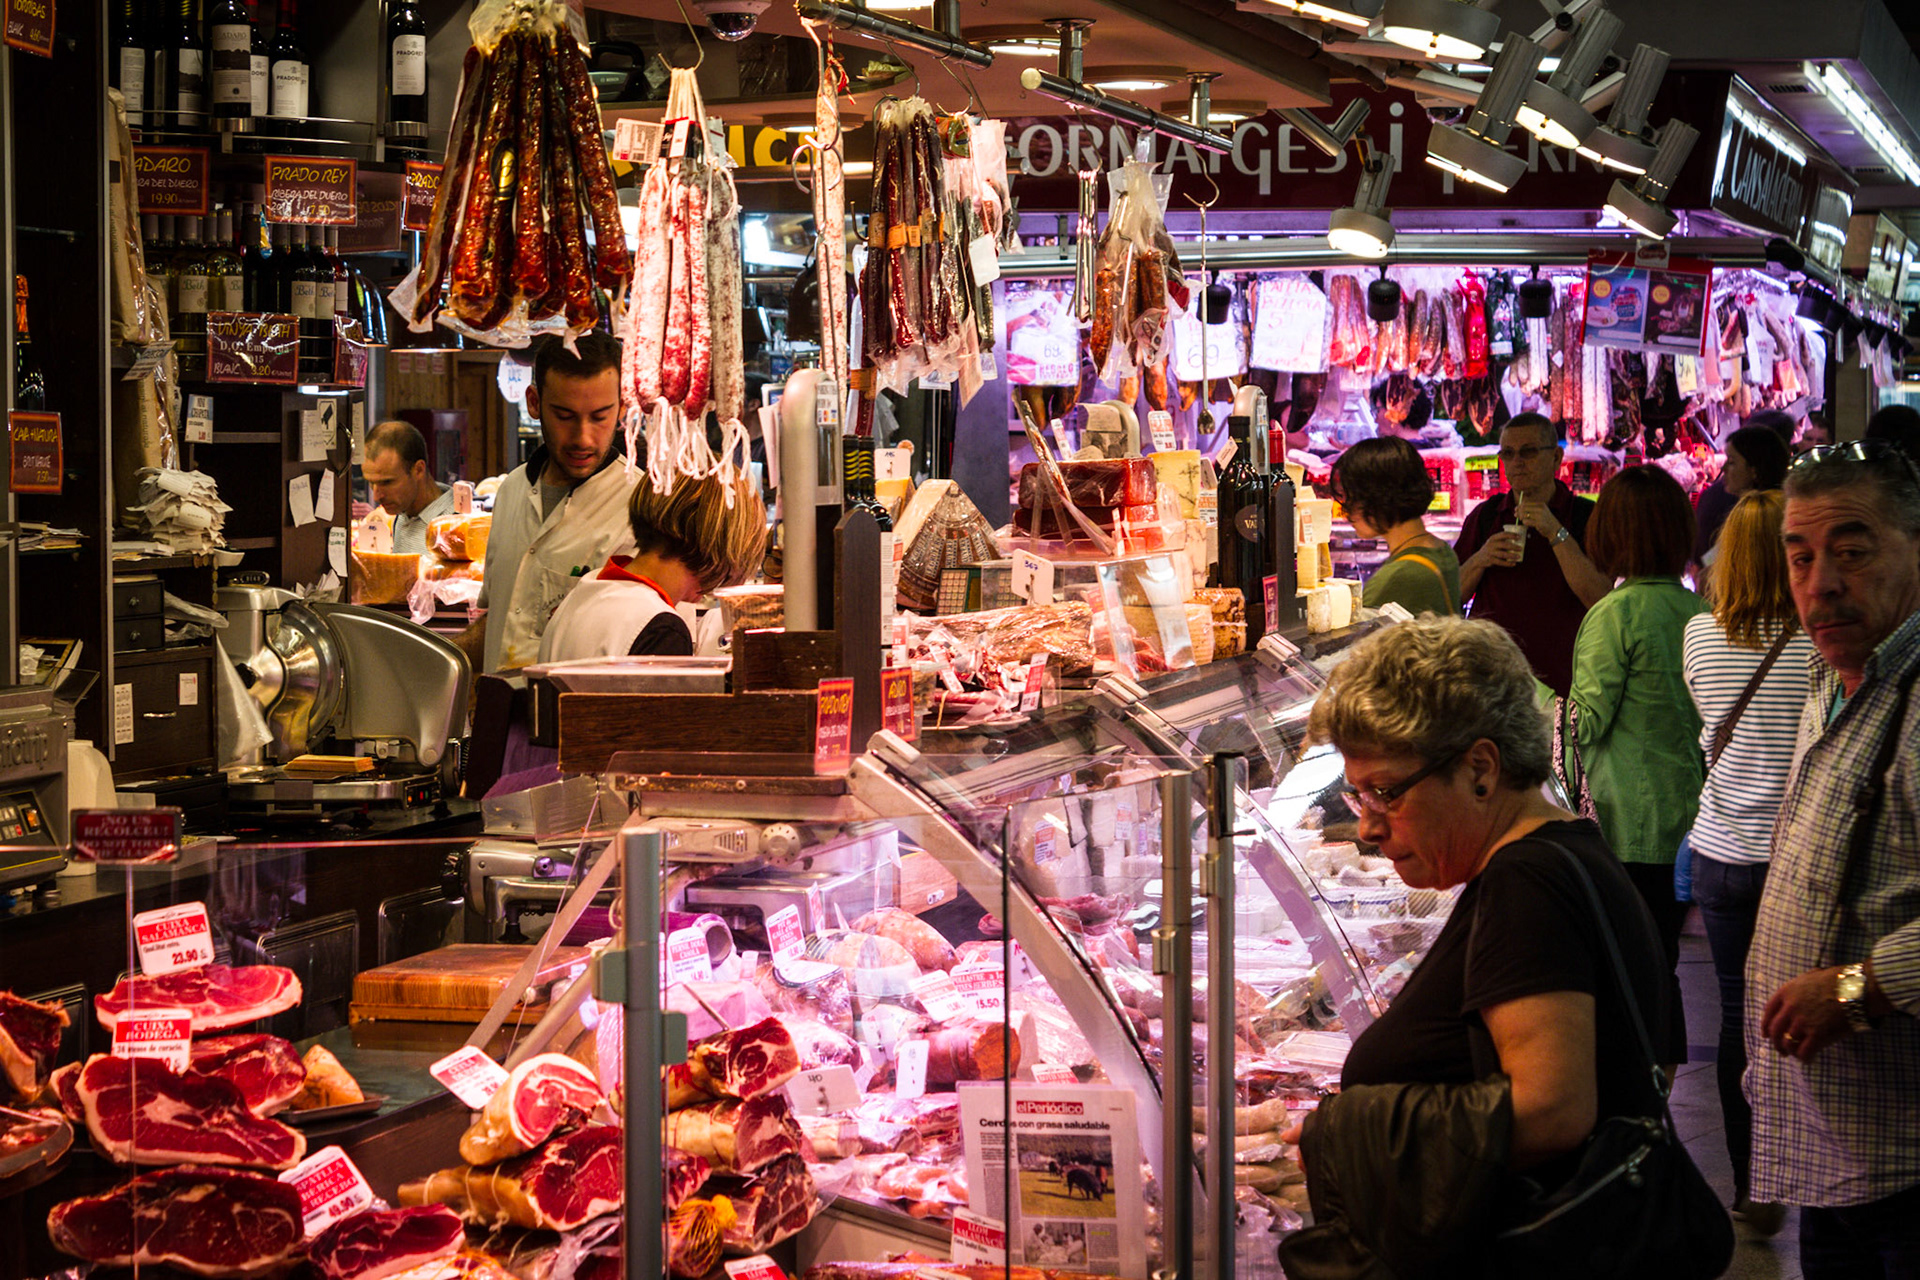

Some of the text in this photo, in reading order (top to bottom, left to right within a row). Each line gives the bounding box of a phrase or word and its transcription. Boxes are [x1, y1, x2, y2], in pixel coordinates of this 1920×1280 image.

[134, 155, 192, 173] ADARO
[1010, 121, 1348, 196] ORMATGES
[168, 178, 199, 189] DUERO
[271, 166, 349, 184] PRADO REY
[319, 189, 349, 201] DUERO
[131, 815, 151, 826] US
[141, 924, 208, 944] SALAMANCA
[171, 948, 199, 966] 23.90
[133, 1021, 174, 1031] CUIXA
[1018, 1119, 1035, 1129] con
[1035, 1120, 1063, 1131] grasa
[1063, 1119, 1111, 1131] saludable
[296, 1160, 344, 1191] SPATLLA
